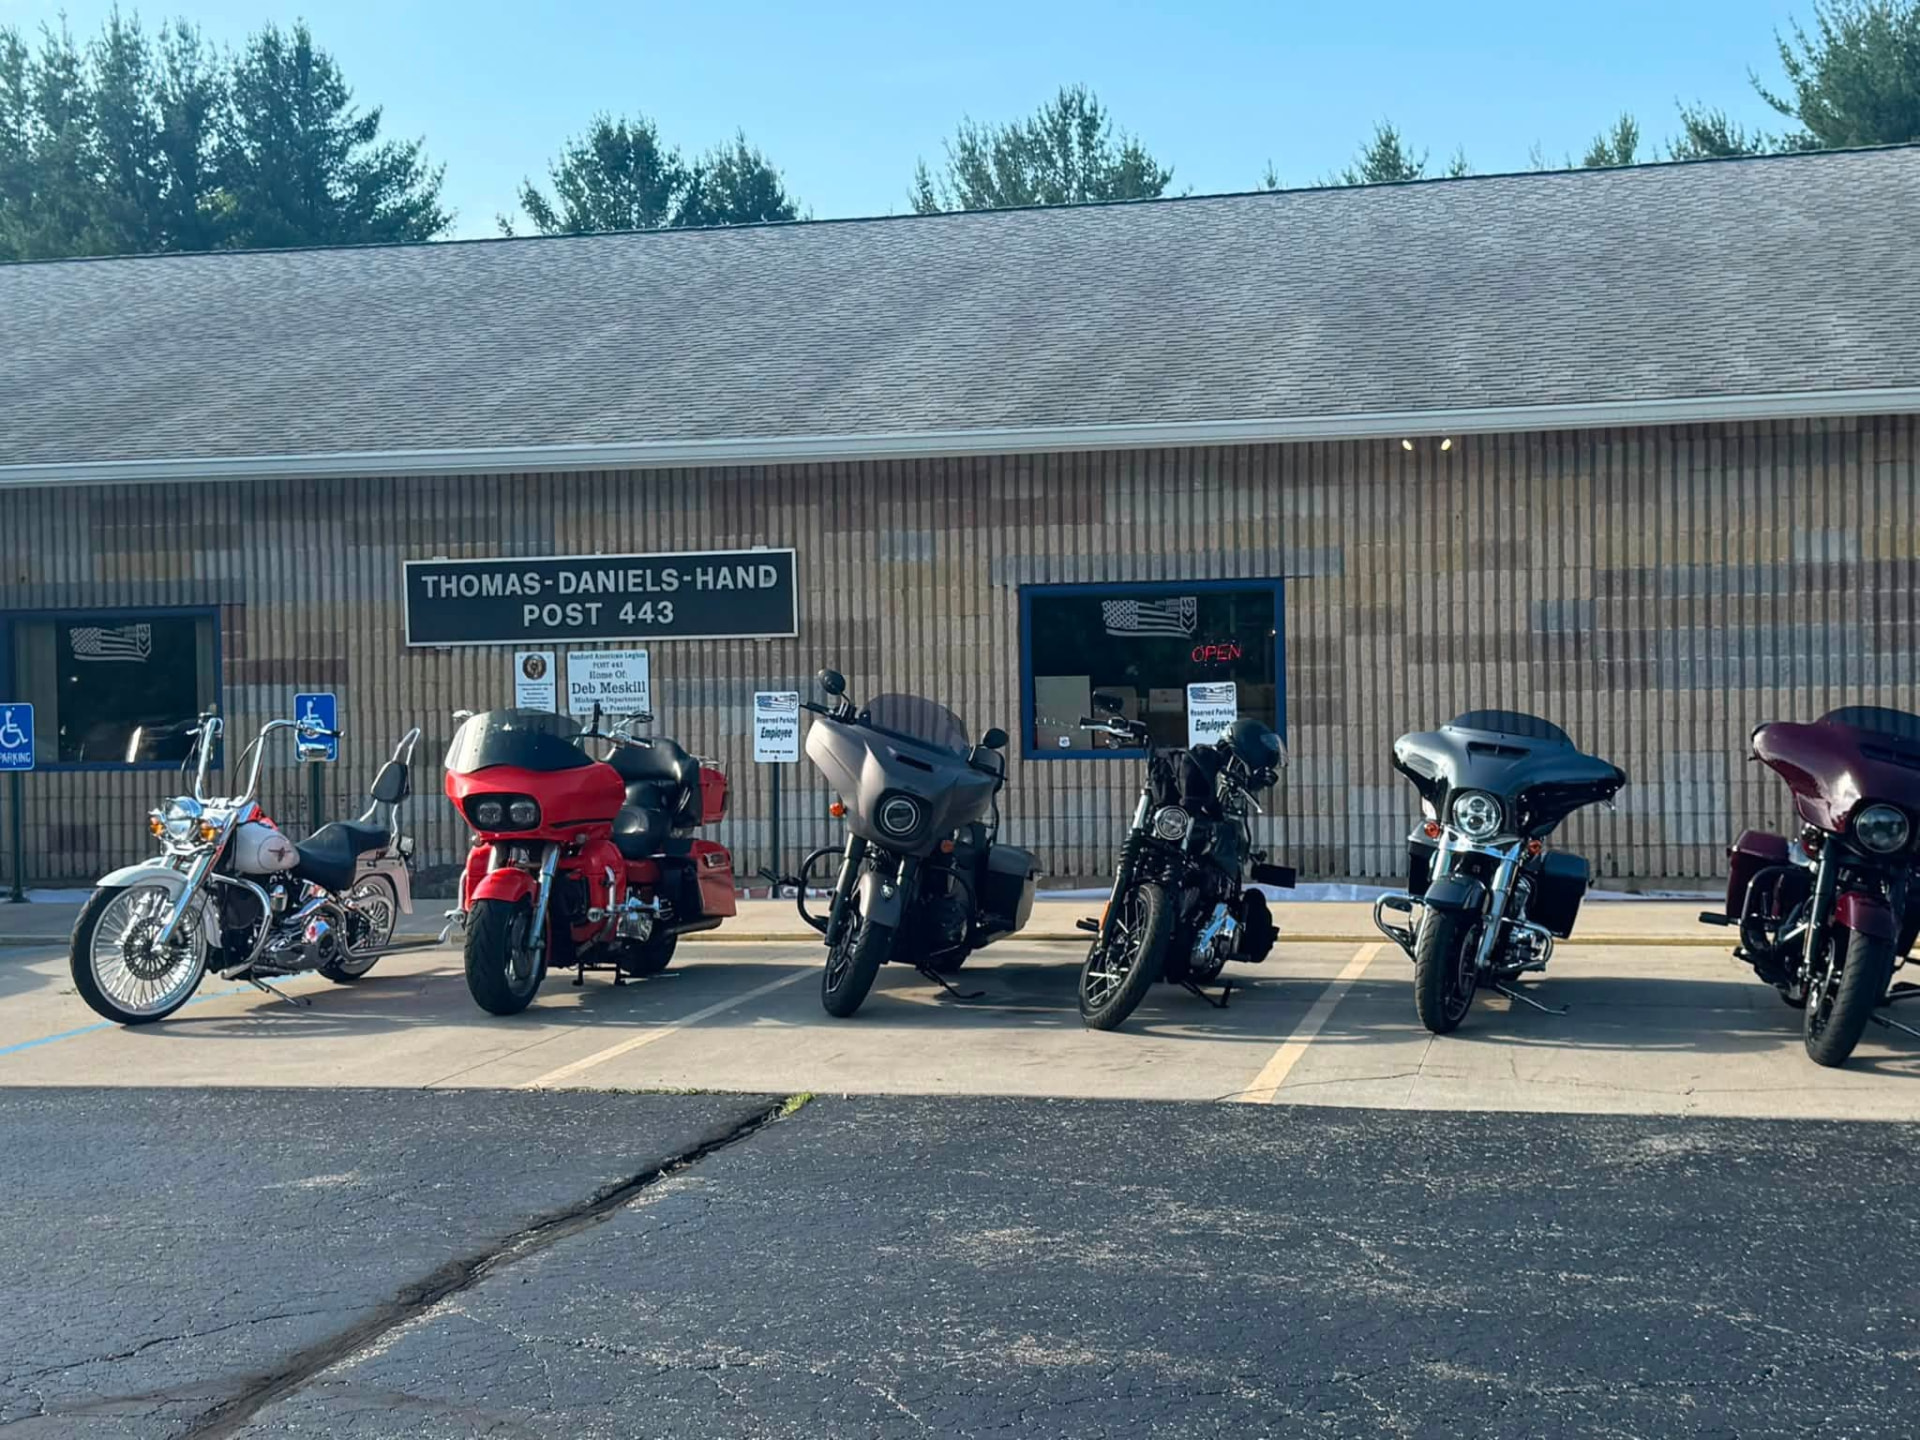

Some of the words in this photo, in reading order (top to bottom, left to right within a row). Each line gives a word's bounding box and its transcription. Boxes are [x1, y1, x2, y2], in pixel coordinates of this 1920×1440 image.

[523, 602, 602, 627] POST
[619, 601, 674, 624] 443
[625, 652, 646, 660] Legion
[1191, 644, 1242, 662] OPEN
[589, 670, 613, 679] Home
[571, 682, 596, 695] Deb
[600, 680, 646, 694] Meskill
[606, 696, 644, 704] Department
[610, 704, 640, 712] President
[1190, 708, 1215, 716] Reserved
[1216, 708, 1235, 717] Parking
[780, 716, 797, 725] Parking
[760, 726, 793, 741] Employee
